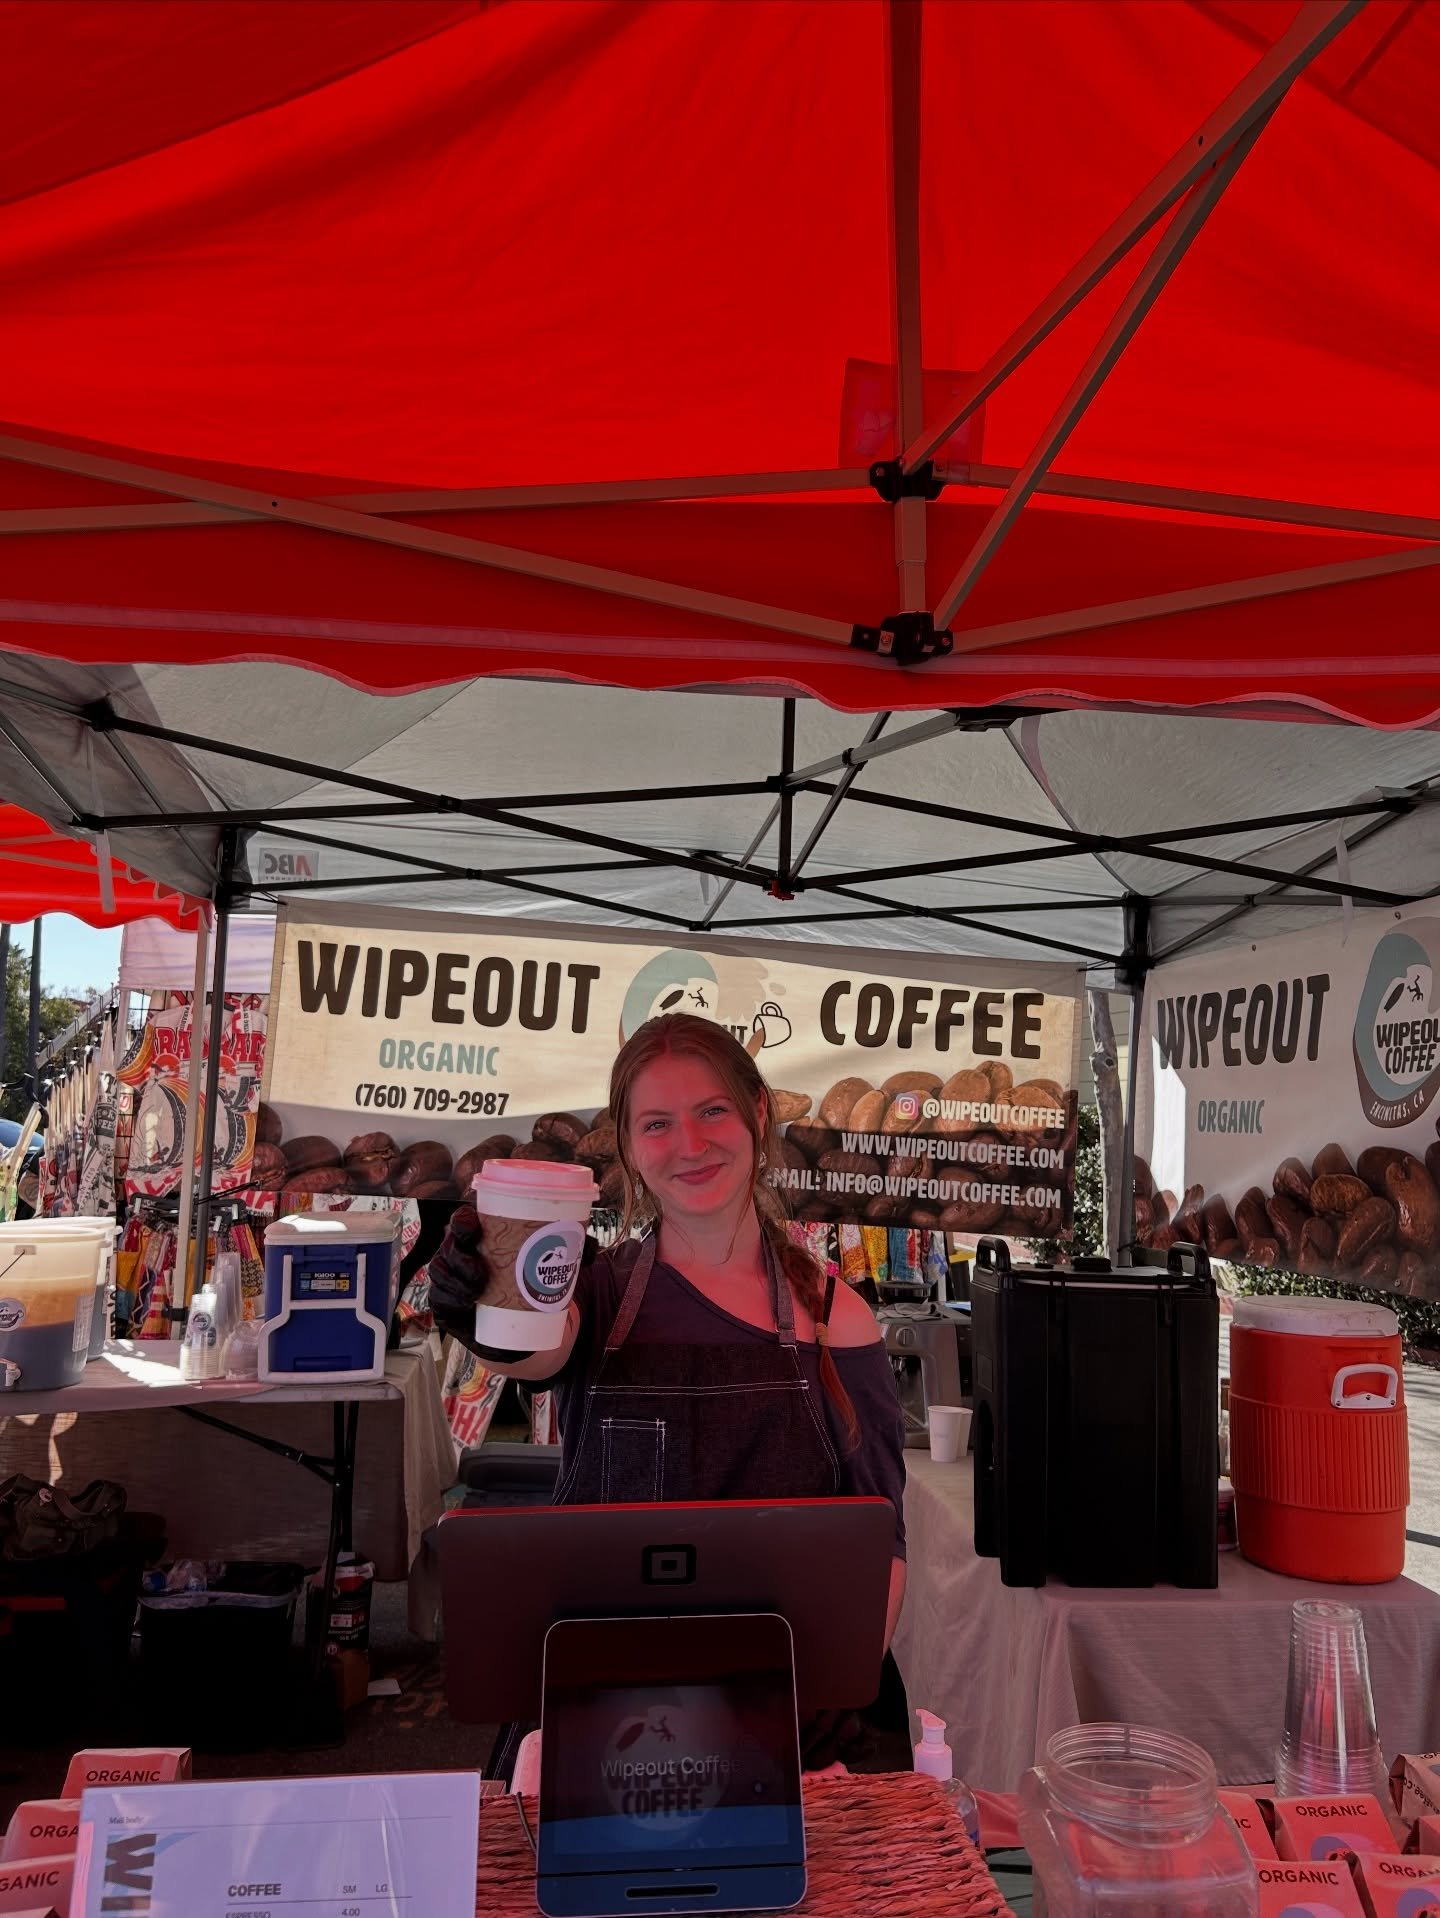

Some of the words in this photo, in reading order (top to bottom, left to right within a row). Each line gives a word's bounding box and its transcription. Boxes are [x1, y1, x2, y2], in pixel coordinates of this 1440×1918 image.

[297, 940, 601, 1034] WIPEOUT
[819, 979, 1045, 1060] COFFEE
[1157, 973, 1331, 1070] WIPEOUT
[378, 1038, 500, 1076] ORGANIC
[1385, 1043, 1437, 1074] COFFEE
[355, 1084, 406, 1109] (760)
[413, 1087, 509, 1116] 709-2987
[922, 1098, 1065, 1129] @WIPEOUTCOFFEE
[1198, 1099, 1265, 1134] ORGANIC
[842, 1132, 1064, 1170] WWW.WIPEOUTCOFFEE.COM
[826, 1171, 1061, 1208] INFO@WIPEOUTCOFFEE.COM
[538, 1262, 575, 1276] WIPEOUT
[542, 1274, 568, 1285] COFFEE
[86, 1770, 160, 1782] ORGANIC
[600, 1759, 675, 1780] Wipeout
[680, 1754, 745, 1776] Coffee
[621, 1788, 704, 1819] COFFEE
[1295, 1804, 1368, 1818] ORGANIC
[228, 1883, 282, 1897] COFFEE
[342, 1885, 357, 1894] SM
[375, 1884, 389, 1893] LG
[1258, 1869, 1339, 1885] ORGANIC
[342, 1908, 360, 1917] 4.00
